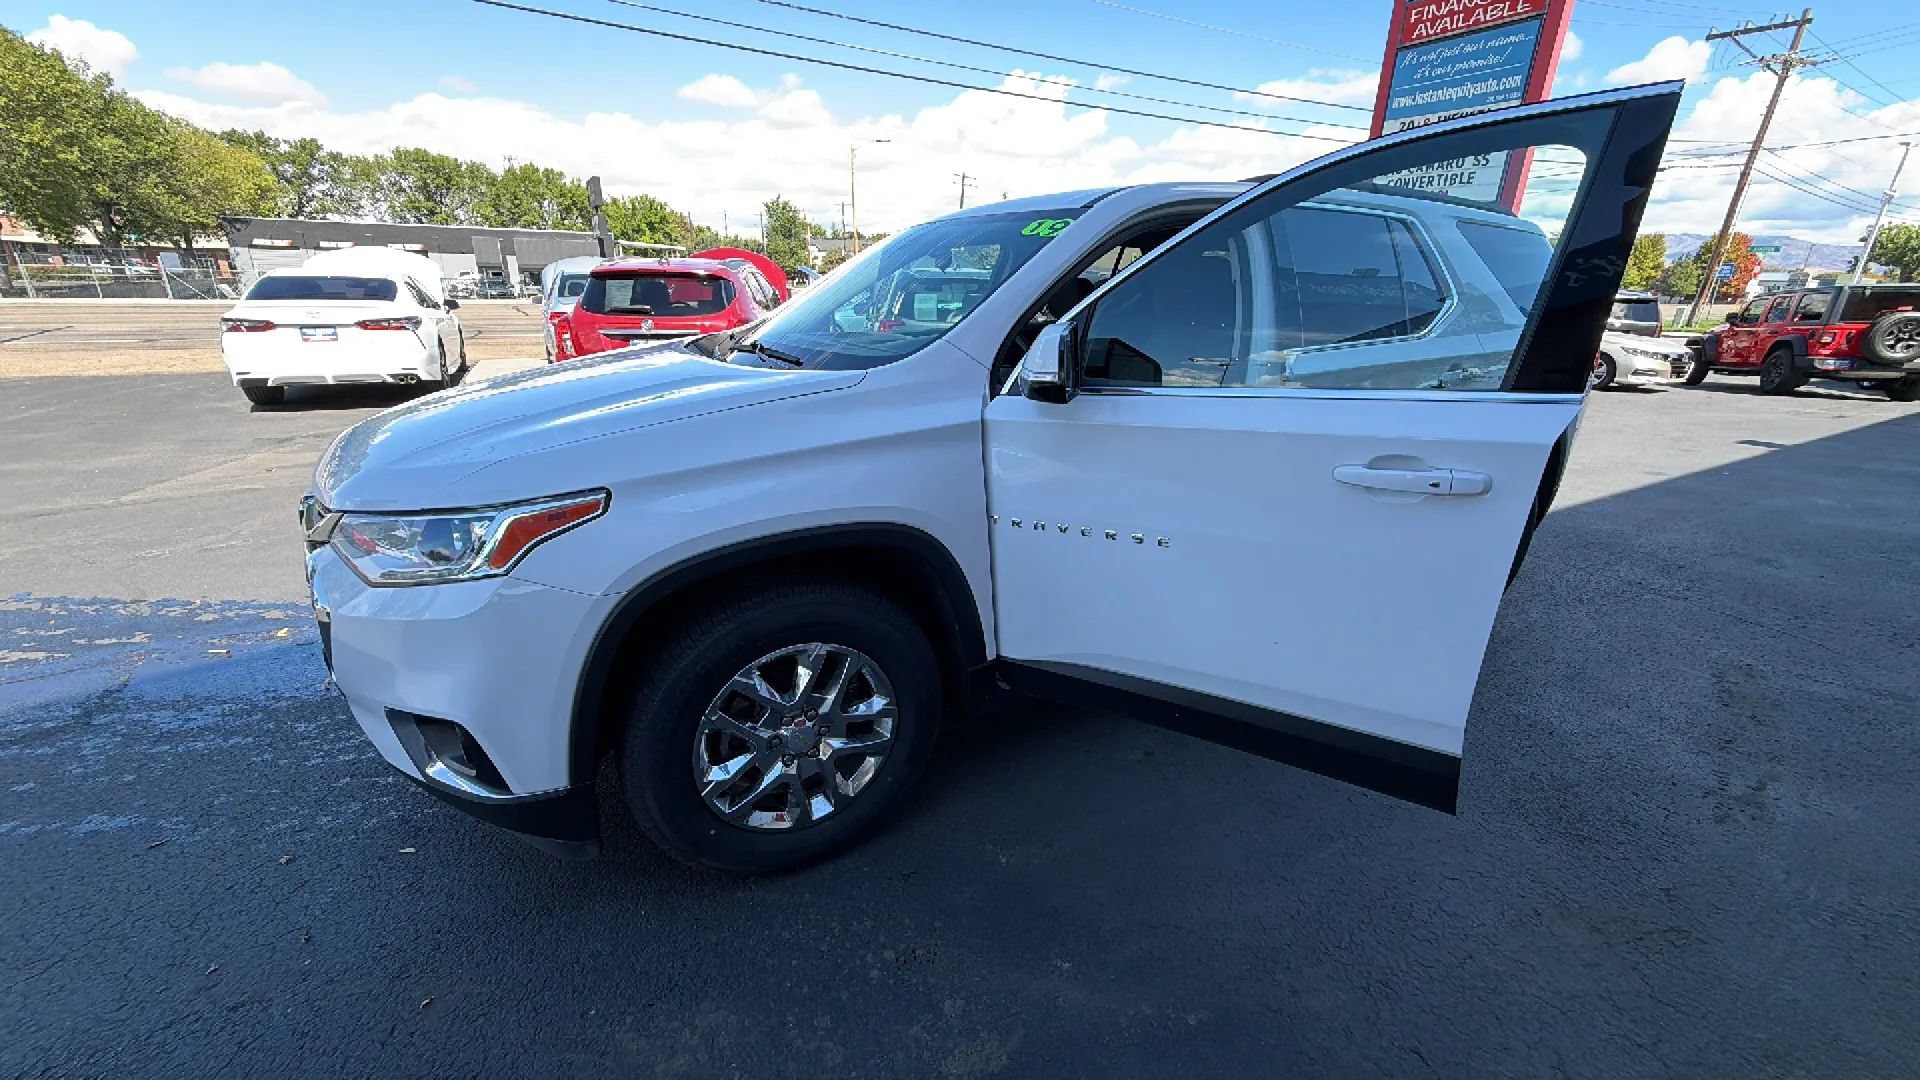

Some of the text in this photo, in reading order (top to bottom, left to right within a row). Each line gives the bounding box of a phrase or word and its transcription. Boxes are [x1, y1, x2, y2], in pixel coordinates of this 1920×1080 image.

[1410, 0, 1491, 23] FINAN
[1411, 0, 1533, 39] AVAILABLE
[989, 514, 1171, 549] TRAVERSE
